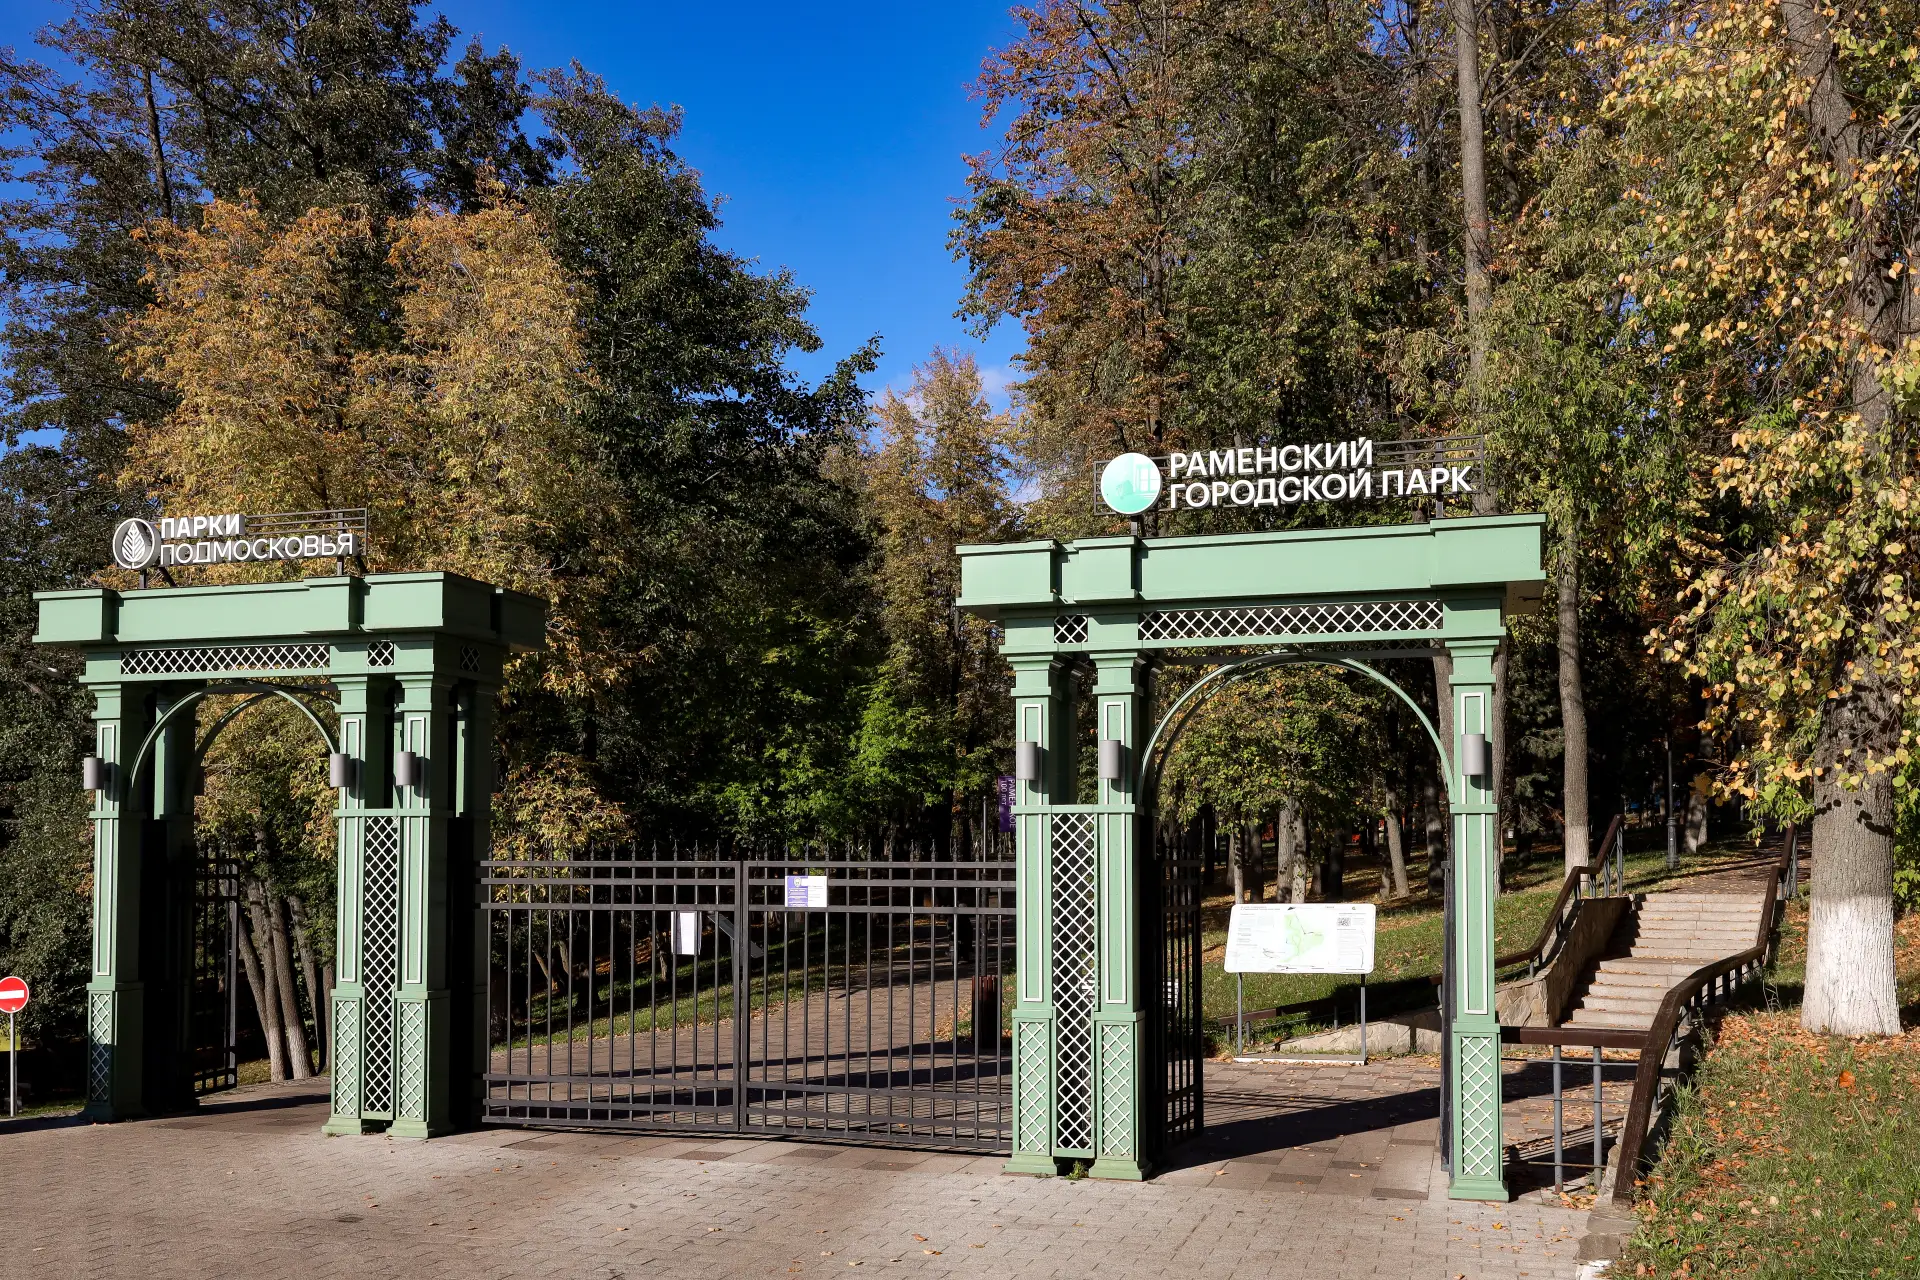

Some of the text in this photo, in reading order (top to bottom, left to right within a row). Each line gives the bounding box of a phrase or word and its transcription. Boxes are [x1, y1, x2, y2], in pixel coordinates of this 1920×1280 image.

[1170, 437, 1373, 478] РАМЕНСКИЙ
[1170, 466, 1473, 509] ГОРОДСКОЙ ПАРК
[160, 513, 241, 539] ПАРКИ
[160, 533, 354, 566] ПОДМОСКОВЬЯ
[1008, 779, 1016, 828] РАМЕНКОЕ
